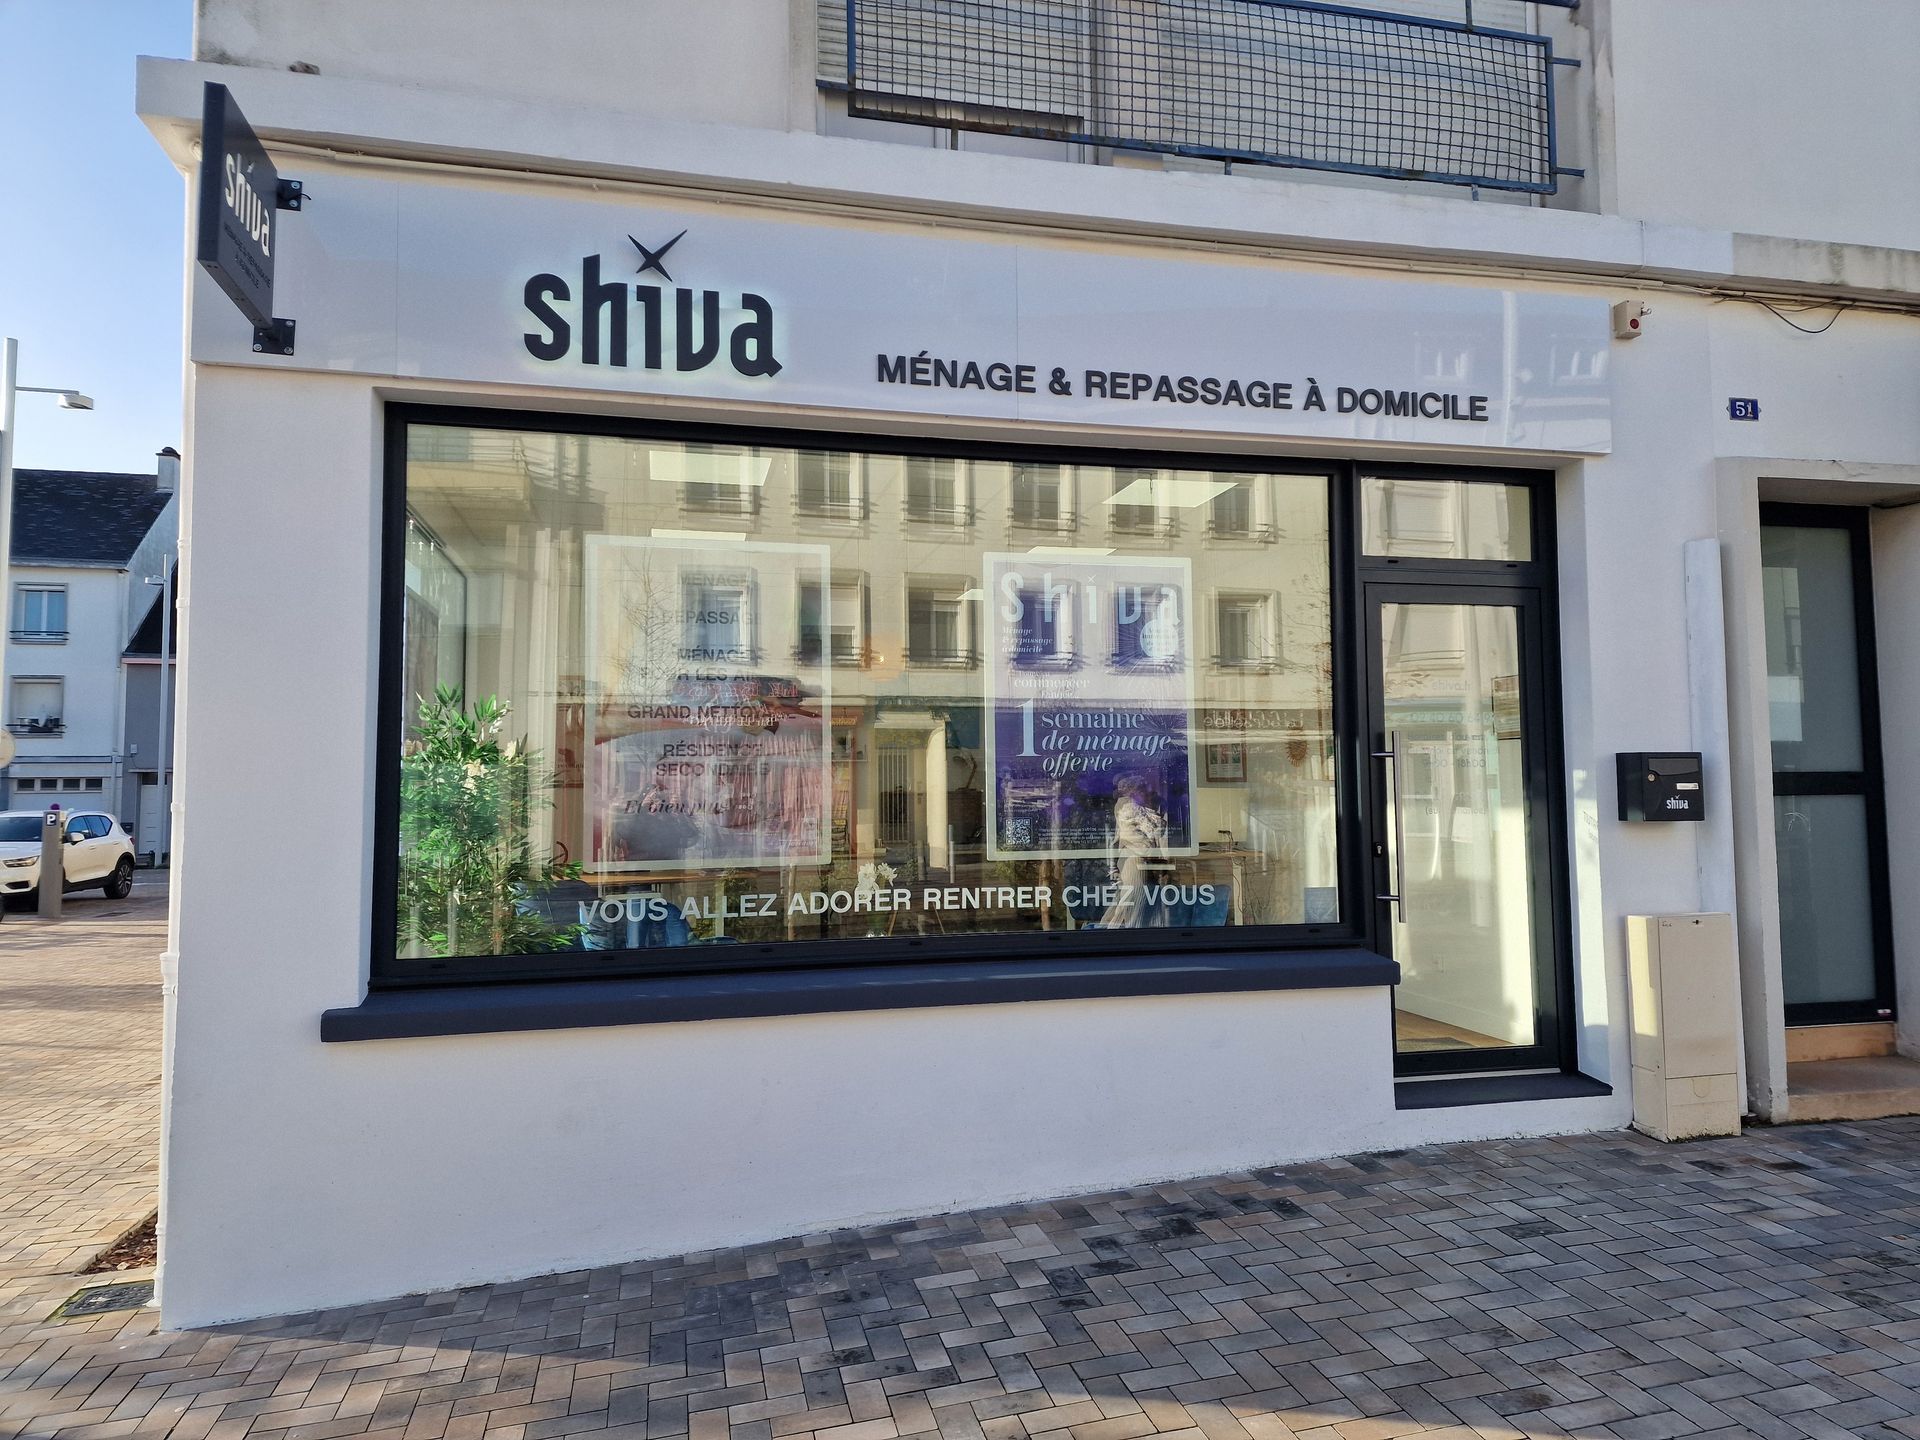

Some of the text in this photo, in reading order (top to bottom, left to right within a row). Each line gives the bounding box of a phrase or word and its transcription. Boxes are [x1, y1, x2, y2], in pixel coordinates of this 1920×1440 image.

[225, 152, 270, 258] shiva
[523, 229, 783, 378] shiva
[877, 350, 1489, 421] MÉNAGE & REPASSAGE À DOMICILE
[1735, 401, 1753, 417] 51
[627, 705, 691, 719] GRAND
[1041, 707, 1146, 729] semaine
[1016, 697, 1042, 757] 1
[1041, 729, 1171, 756] de ménage
[1042, 752, 1113, 777] offerte
[1666, 796, 1689, 809] shiva
[46, 814, 56, 826] P
[578, 884, 1216, 924] VOUS ALLEZ ADORER RENTRER CHEZ VOUS
